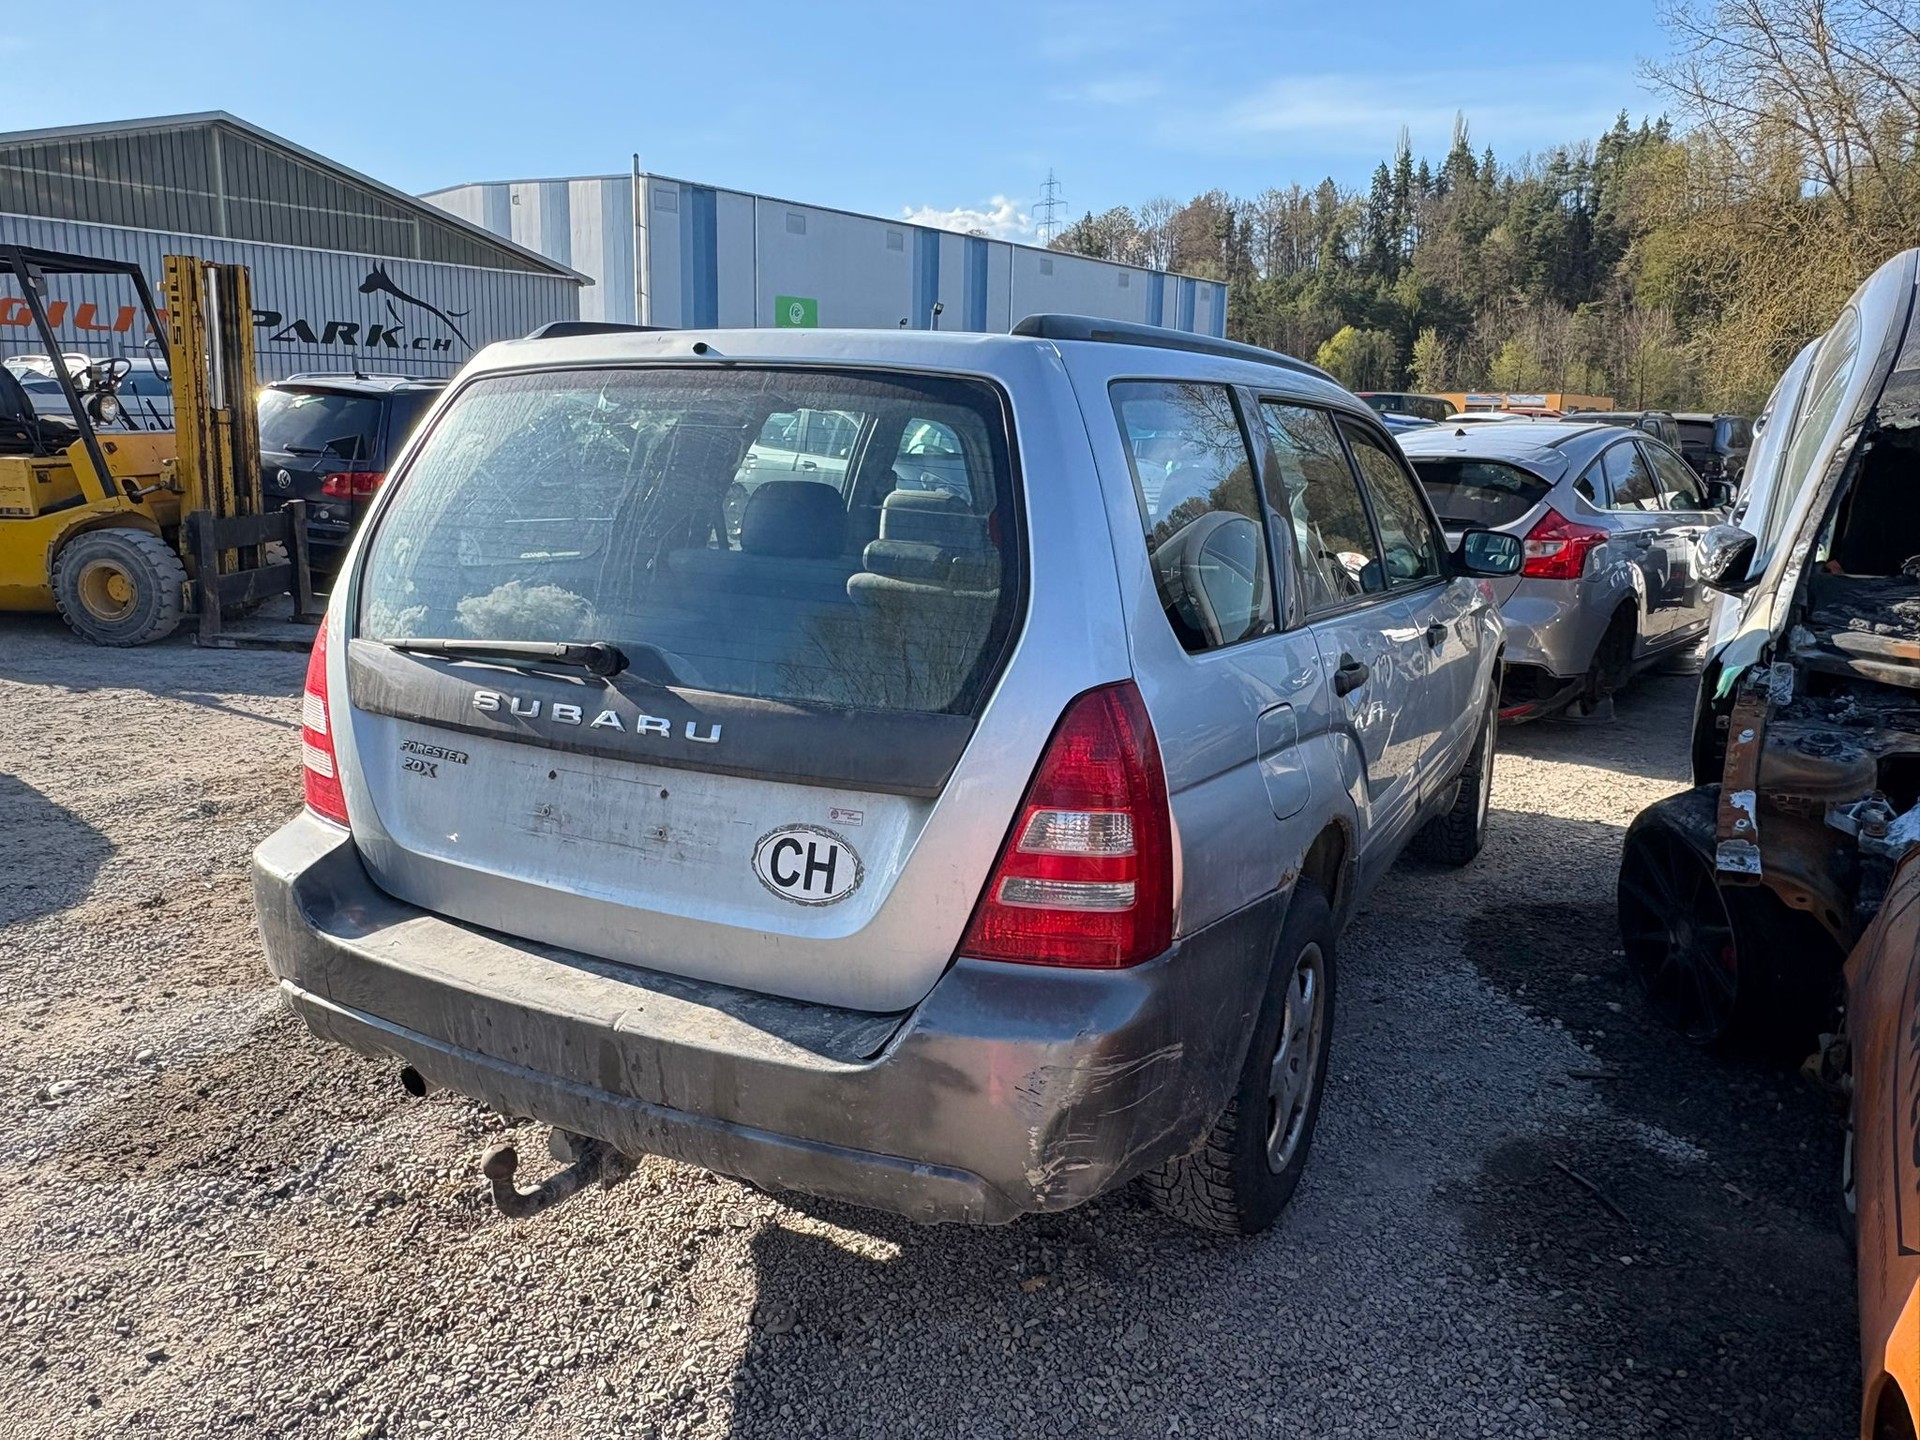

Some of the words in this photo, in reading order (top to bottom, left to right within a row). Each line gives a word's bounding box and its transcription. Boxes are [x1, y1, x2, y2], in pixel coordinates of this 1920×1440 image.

[169, 257, 181, 345] STILL
[473, 690, 722, 743] SUBARU
[400, 739, 469, 765] FORESTER
[770, 837, 838, 894] CH
